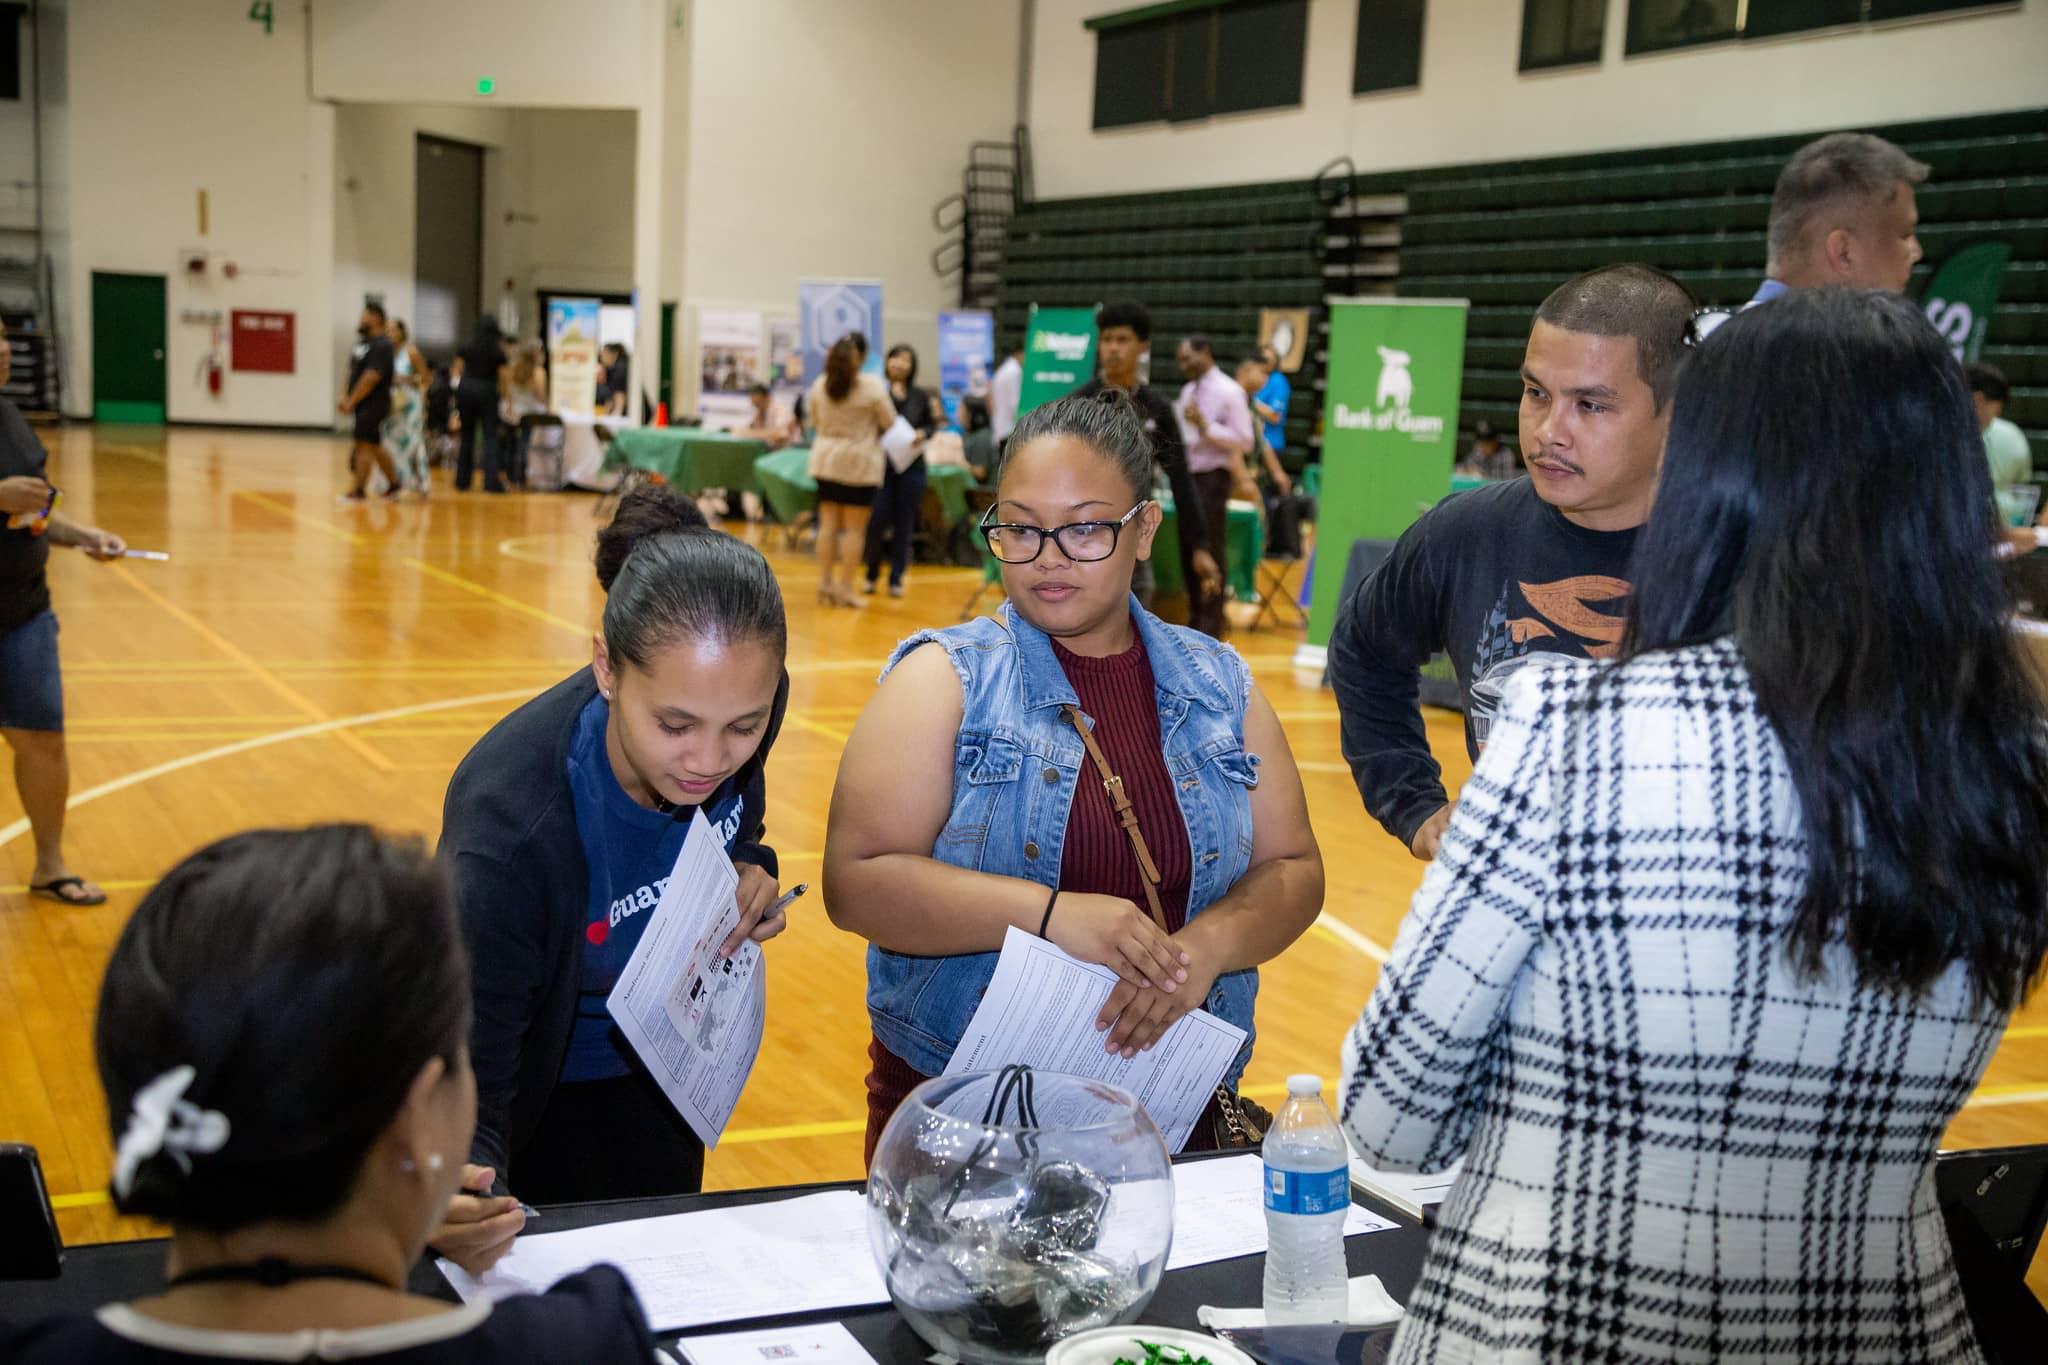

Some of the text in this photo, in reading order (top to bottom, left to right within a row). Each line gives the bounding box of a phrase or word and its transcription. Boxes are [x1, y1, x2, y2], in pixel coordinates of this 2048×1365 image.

[249, 0, 273, 36] 4
[1334, 403, 1444, 433] Bank of Guam
